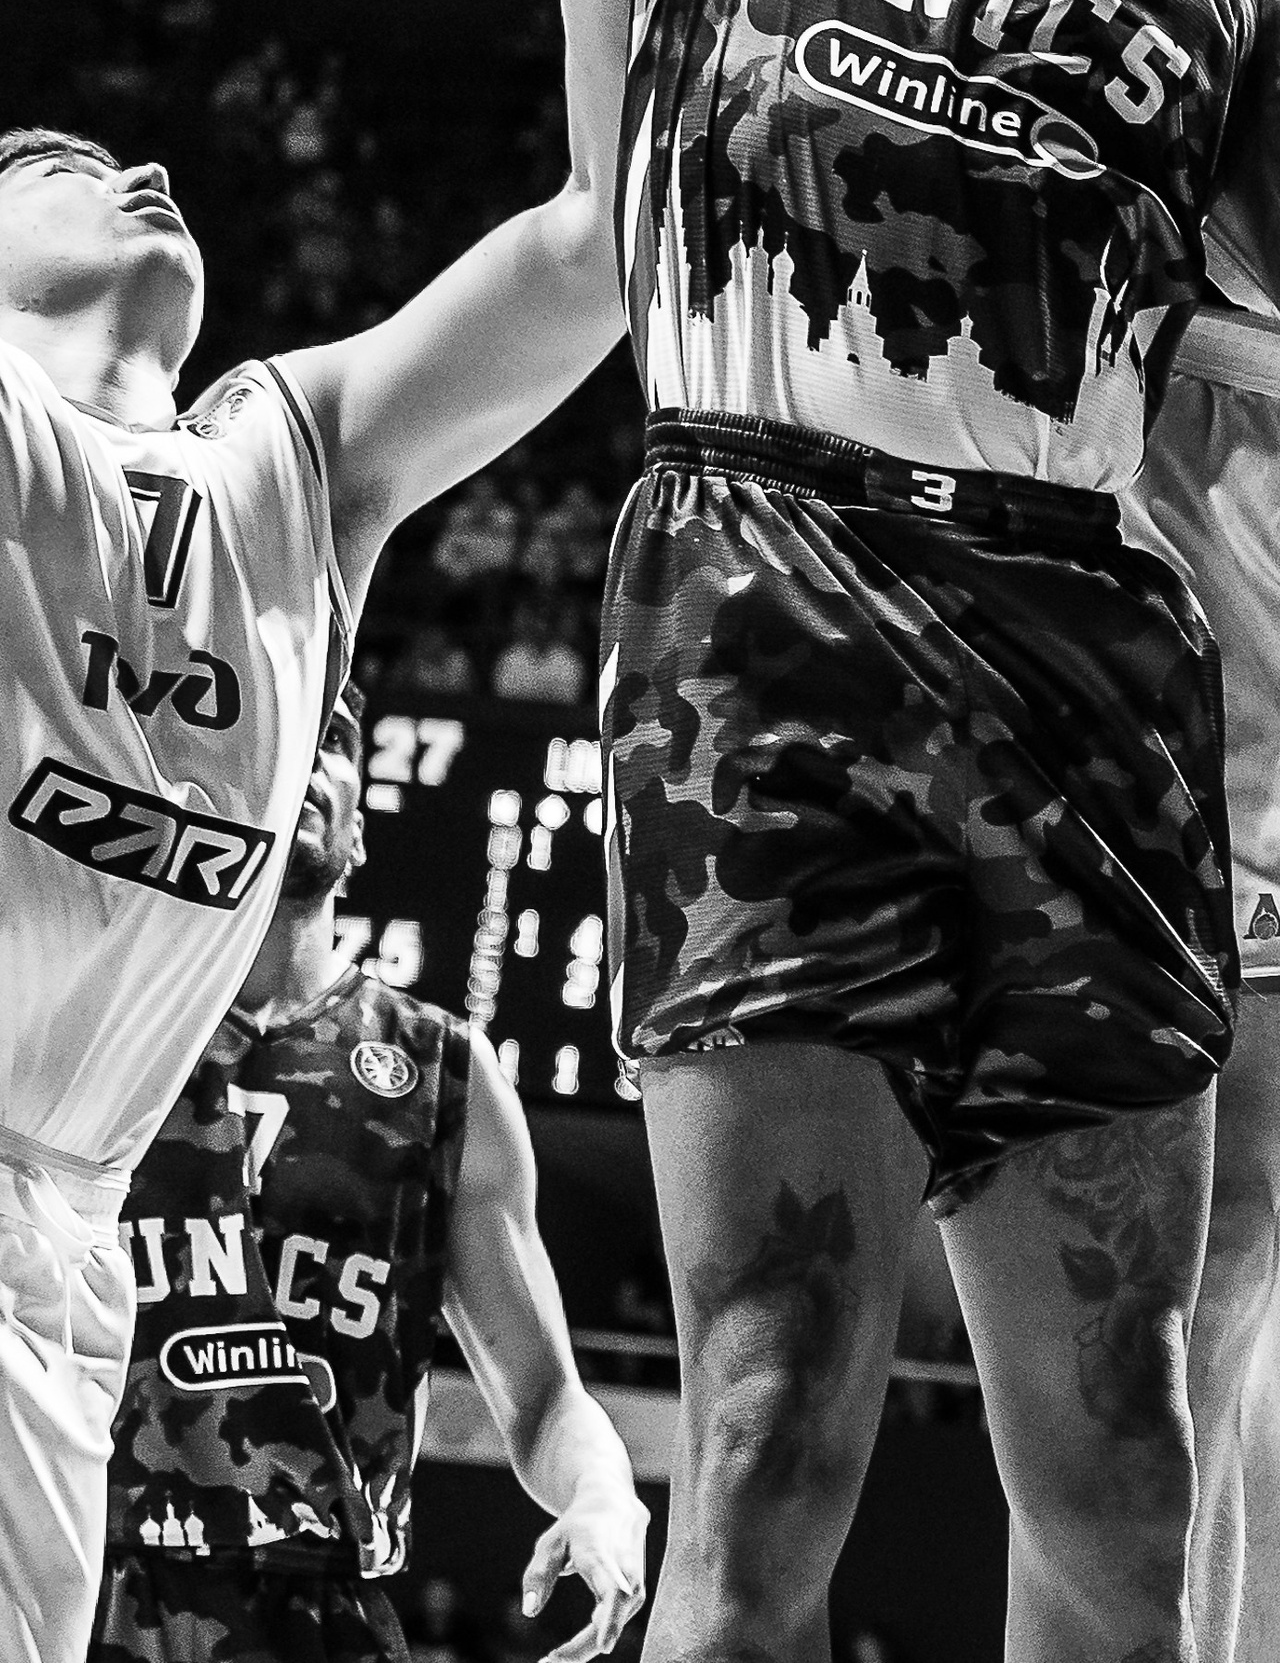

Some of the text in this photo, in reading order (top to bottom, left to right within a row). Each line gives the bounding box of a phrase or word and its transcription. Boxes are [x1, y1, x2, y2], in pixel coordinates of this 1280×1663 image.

[828, 39, 1022, 138] Winline
[910, 469, 956, 512] 3
[367, 715, 466, 787] 27
[22, 770, 268, 899] PARI
[227, 1082, 290, 1196] 7
[119, 1213, 391, 1339] UNCS
